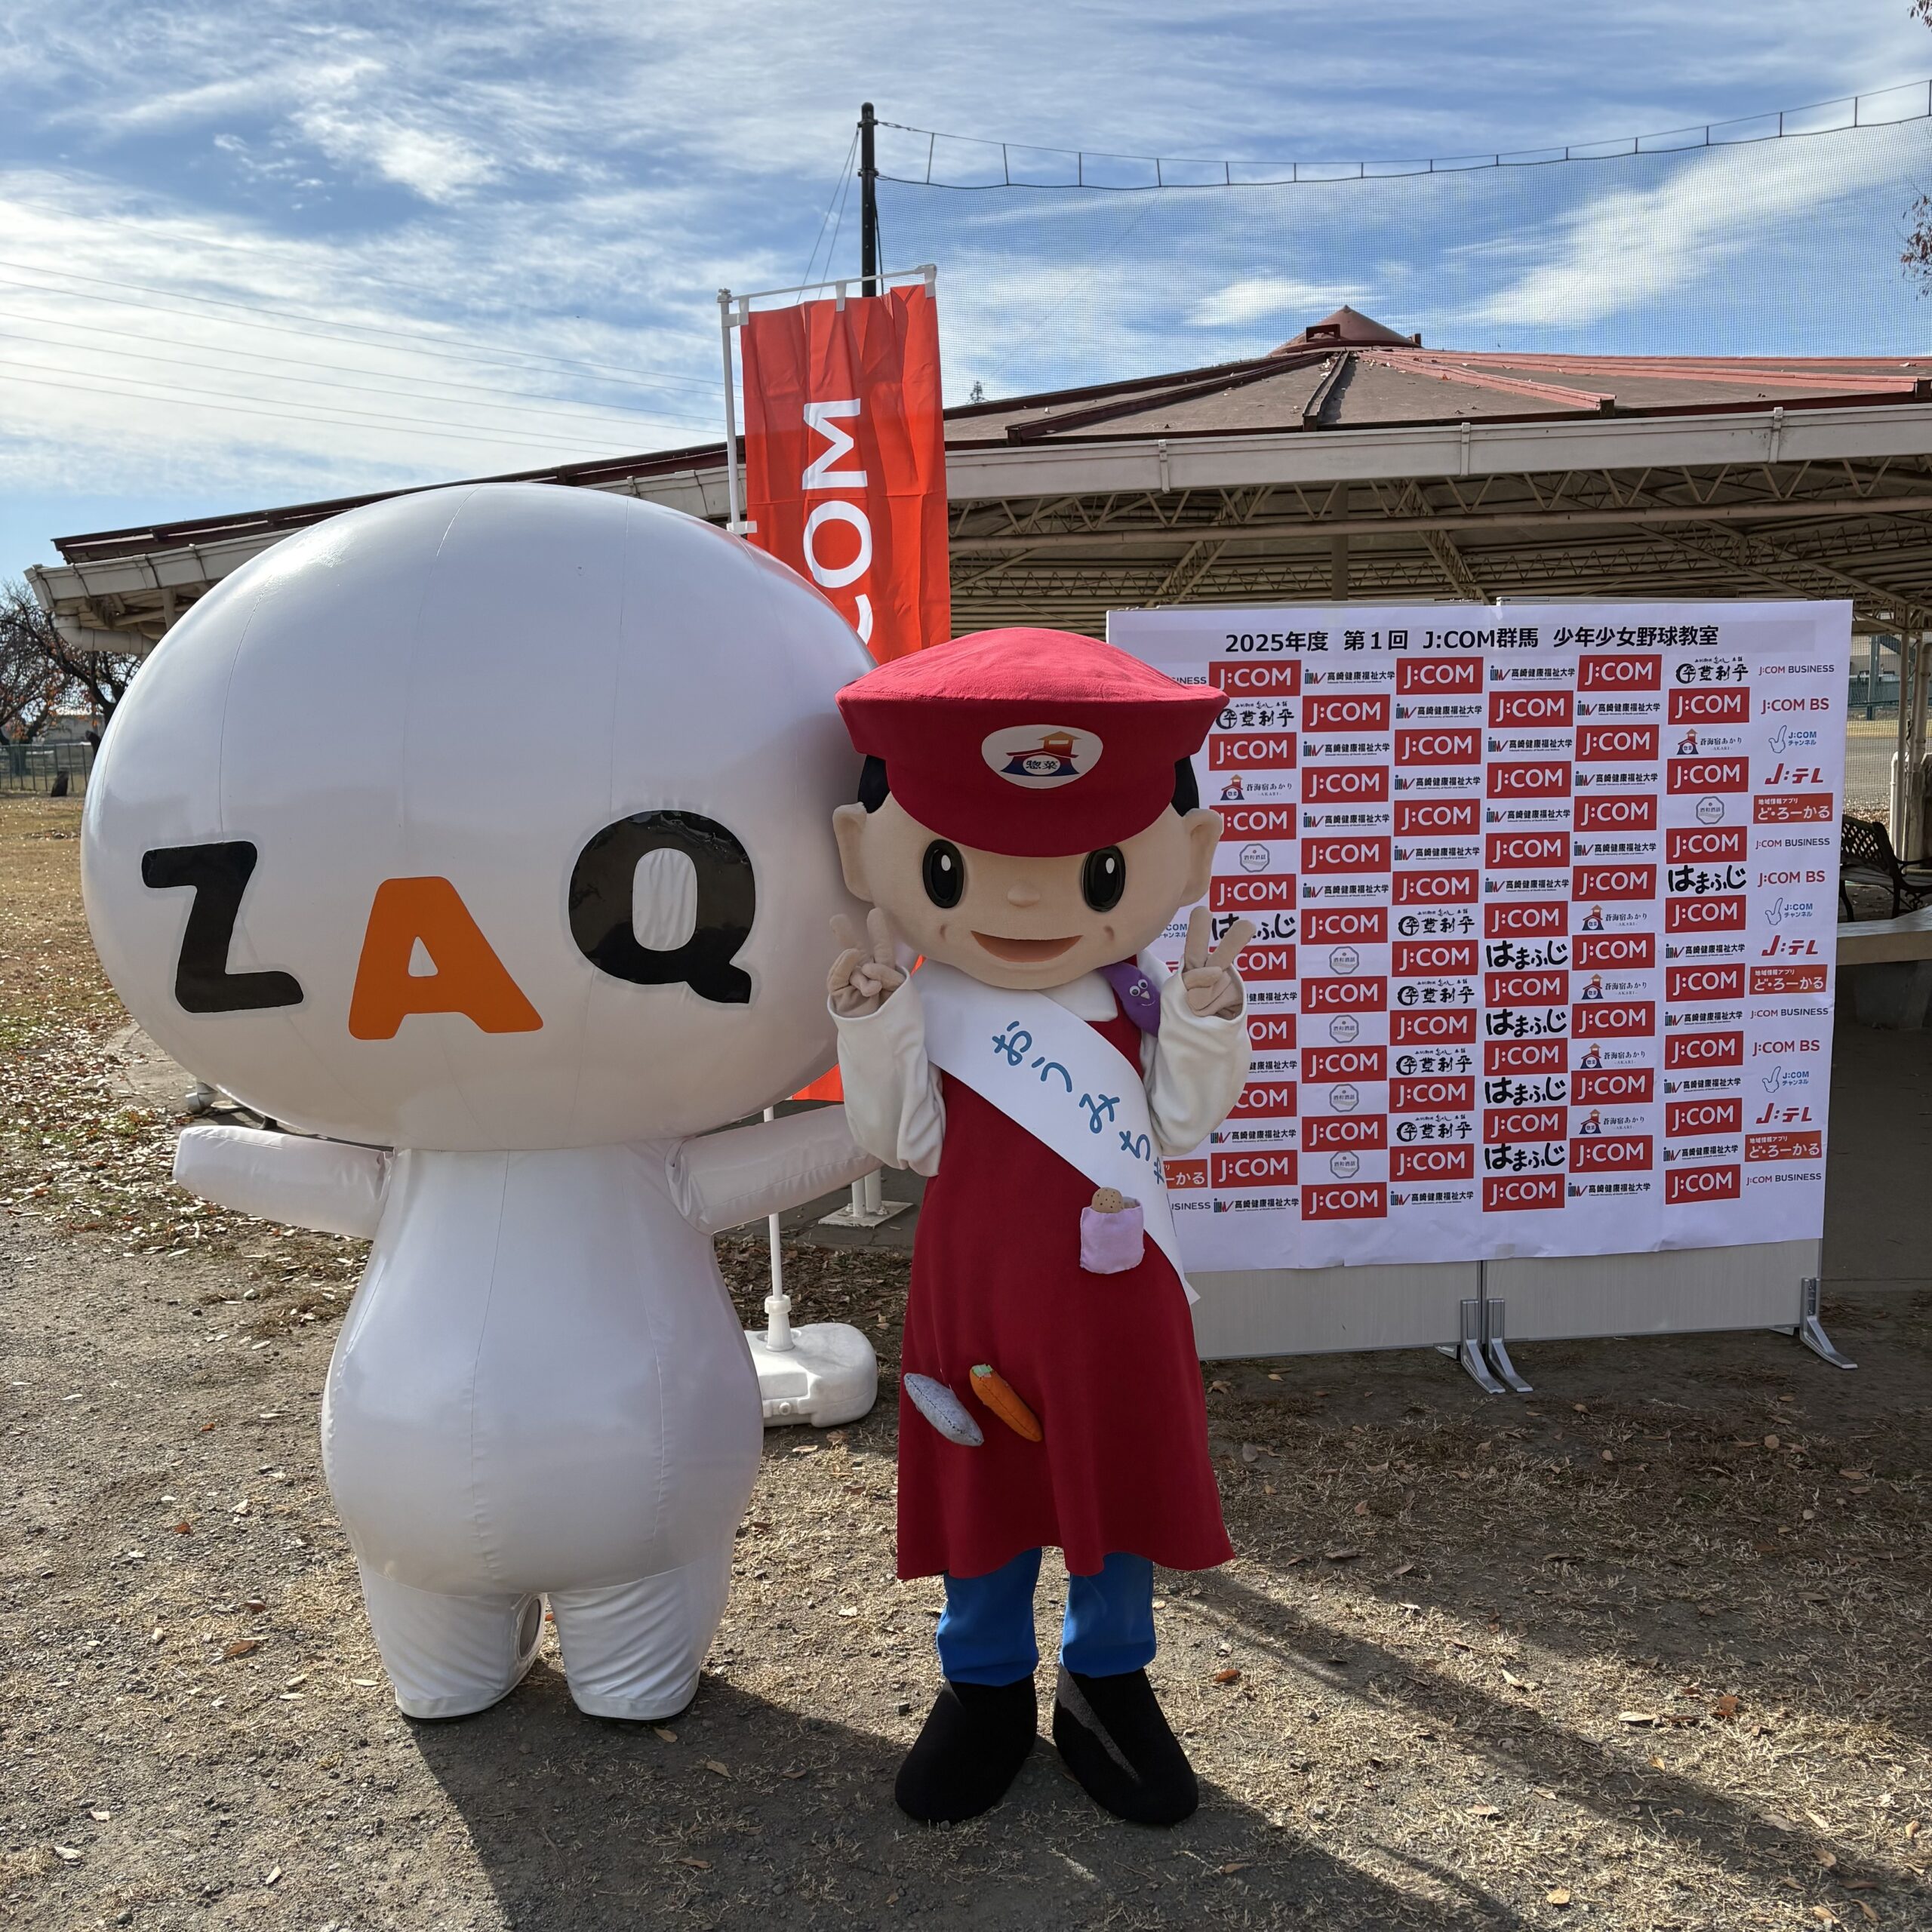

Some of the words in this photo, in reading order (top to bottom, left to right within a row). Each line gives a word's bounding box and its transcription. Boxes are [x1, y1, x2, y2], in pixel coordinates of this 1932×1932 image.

[801, 398, 873, 645] OM
[1225, 631, 1329, 653] 2025年度
[1343, 630, 1408, 651] 第1回
[1423, 628, 1539, 649] J:COM群馬
[1553, 626, 1719, 648] 少年少女野球教室
[1220, 667, 1291, 691] J:COM
[1327, 670, 1395, 681] 高崎健康福祉大学
[1403, 664, 1474, 689] J:COM
[1512, 667, 1575, 678] 高崎健康福祉大学
[1584, 662, 1653, 686] J:COM
[1758, 666, 1785, 675] J:COM
[1788, 664, 1835, 673] BUSINESS
[1309, 701, 1381, 727] J:COM
[1417, 705, 1482, 715] 高崎健康福祉大学
[1495, 697, 1564, 722] J:COM
[1598, 703, 1660, 712] 高崎健康福祉大学
[1675, 694, 1741, 719] J:COM
[1761, 700, 1805, 715] J:COM
[1810, 697, 1829, 710] BS
[1216, 740, 1287, 764] J:COM
[1324, 743, 1390, 753] 高崎健康福祉大学
[1401, 735, 1472, 760] J:COM
[1509, 739, 1572, 749] 高崎健康福祉大学
[1582, 731, 1651, 755] J:COM
[1309, 773, 1380, 798] J:COM
[1416, 777, 1481, 786] 高崎健康福祉大学
[1494, 768, 1563, 792] J:COM
[1595, 773, 1658, 783] 高崎健康福祉大学
[1673, 764, 1740, 789] J:COM
[1324, 814, 1390, 825] 高崎健康福祉大学
[1401, 806, 1471, 831] J:COM
[1507, 809, 1571, 820] 高崎健康福祉大学
[1580, 801, 1648, 826] J:COM
[1308, 843, 1380, 869] J:COM
[1416, 847, 1480, 857] 高崎健康福祉大学
[1492, 838, 1561, 863] J:COM
[1594, 842, 1657, 852] 高崎健康福祉大学
[1672, 833, 1739, 858] J:COM
[1755, 840, 1782, 849] J:COM
[1785, 838, 1830, 847] BUSINESS
[1324, 884, 1389, 894] 高崎健康福祉大学
[1399, 876, 1469, 901] J:COM
[1506, 879, 1569, 889] 高崎健康福祉大学
[1579, 871, 1647, 896] J:COM
[1668, 865, 1747, 894] はまふじ
[1758, 872, 1801, 887] J:COM
[1805, 870, 1826, 883] BS
[1217, 881, 1287, 906] J:COM
[141, 810, 755, 1040] ZAQ
[1211, 913, 1296, 940] はふじ
[1308, 914, 1379, 939] J:COM
[1491, 908, 1559, 933] J:COM
[1672, 902, 1737, 927] J:COM
[1398, 947, 1469, 971] J:COM
[1486, 940, 1568, 970] はまふじ
[1579, 940, 1647, 964] J:COM
[1685, 943, 1745, 954] 高崎健康福祉大学
[1308, 983, 1378, 1008] J:COM
[1492, 977, 1560, 1001] J:COM
[1672, 971, 1737, 996] J:COM
[1246, 992, 1298, 1002] 健康福祉大学
[1486, 1009, 1567, 1037] はまふじ
[1578, 1008, 1646, 1033] J:COM
[1684, 1011, 1743, 1022] 高崎健康福祉大学
[1751, 1010, 1778, 1019] J:COM
[1780, 1008, 1829, 1017] BUSINESS
[1397, 1015, 1468, 1040] J:COM
[1491, 1045, 1559, 1070] J:COM
[1671, 1038, 1735, 1063] J:COM
[1752, 1041, 1795, 1056] J:COM
[1799, 1039, 1820, 1052] BS
[1309, 1053, 1378, 1078] J:COM
[1396, 1083, 1466, 1107] J:COM
[1484, 1077, 1566, 1106] はまふじ
[1577, 1075, 1645, 1100] J:COM
[1683, 1078, 1741, 1088] 高崎健康福祉大学
[1491, 1113, 1558, 1138] J:COM
[1672, 1105, 1734, 1131] J:COM
[1232, 1130, 1297, 1140] 高崎健康福祉大学
[1309, 1121, 1378, 1146] J:COM
[1484, 1143, 1565, 1171] はまふじ
[1576, 1142, 1644, 1167] J:COM
[1681, 1145, 1738, 1156] 高崎健康福祉大学
[1218, 1157, 1288, 1183] J:COM
[1396, 1151, 1465, 1176] J:COM
[1589, 1183, 1651, 1193] 高崎健康福祉大学
[1671, 1171, 1732, 1198] J:COM
[1746, 1176, 1772, 1186] J:COM
[1775, 1173, 1822, 1182] BUSINESS
[1235, 1198, 1299, 1209] 高崎健康福祉大学
[1309, 1189, 1378, 1214] J:COM
[1411, 1191, 1474, 1201] 高崎健康福祉大学
[1489, 1180, 1556, 1206] J:COM
